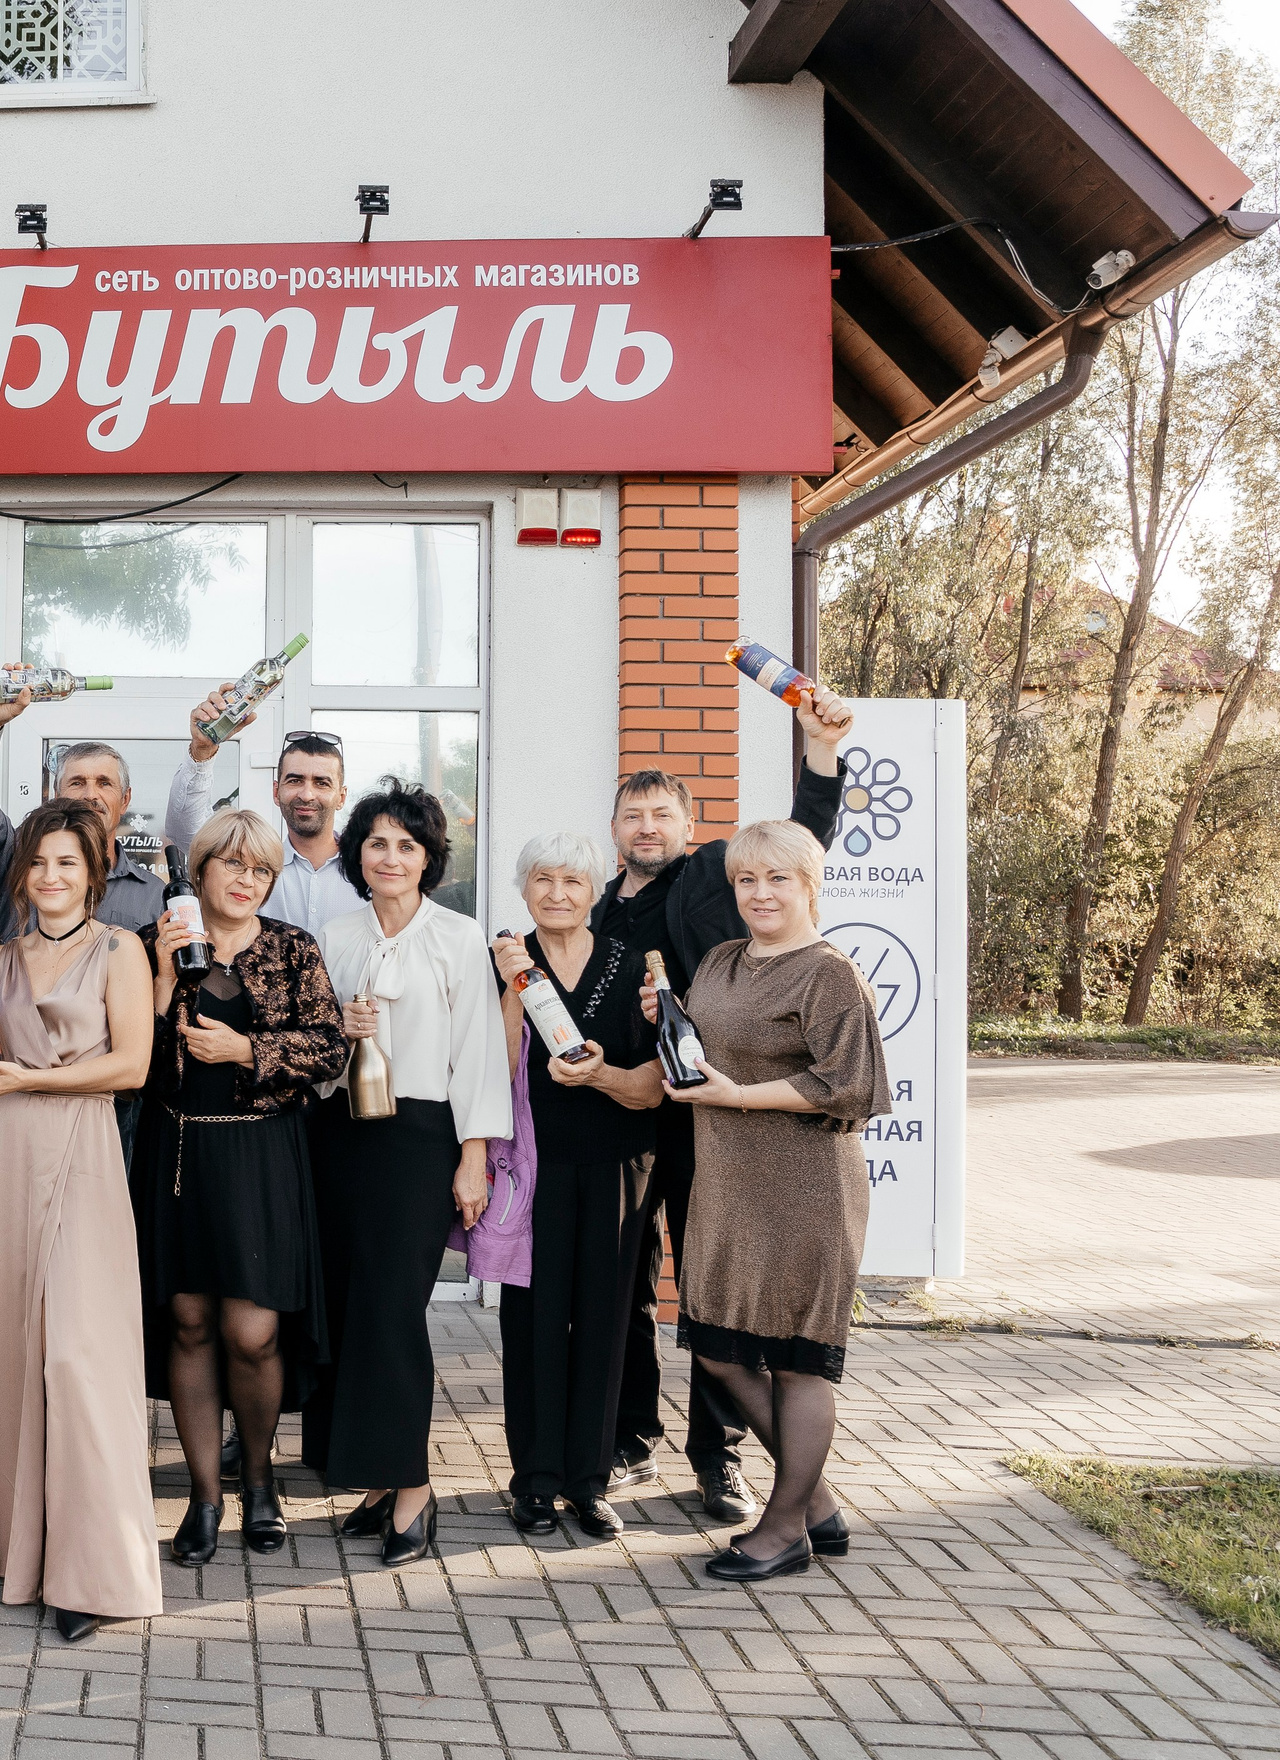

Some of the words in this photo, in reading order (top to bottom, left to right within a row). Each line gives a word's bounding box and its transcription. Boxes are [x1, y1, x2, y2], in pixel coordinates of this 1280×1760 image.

[94, 269, 160, 292] сеть
[174, 265, 460, 297] оптово-розничных
[474, 263, 640, 287] магазинов
[868, 866, 925, 886] ВОДА
[858, 888, 905, 899] ЖИЗНИ
